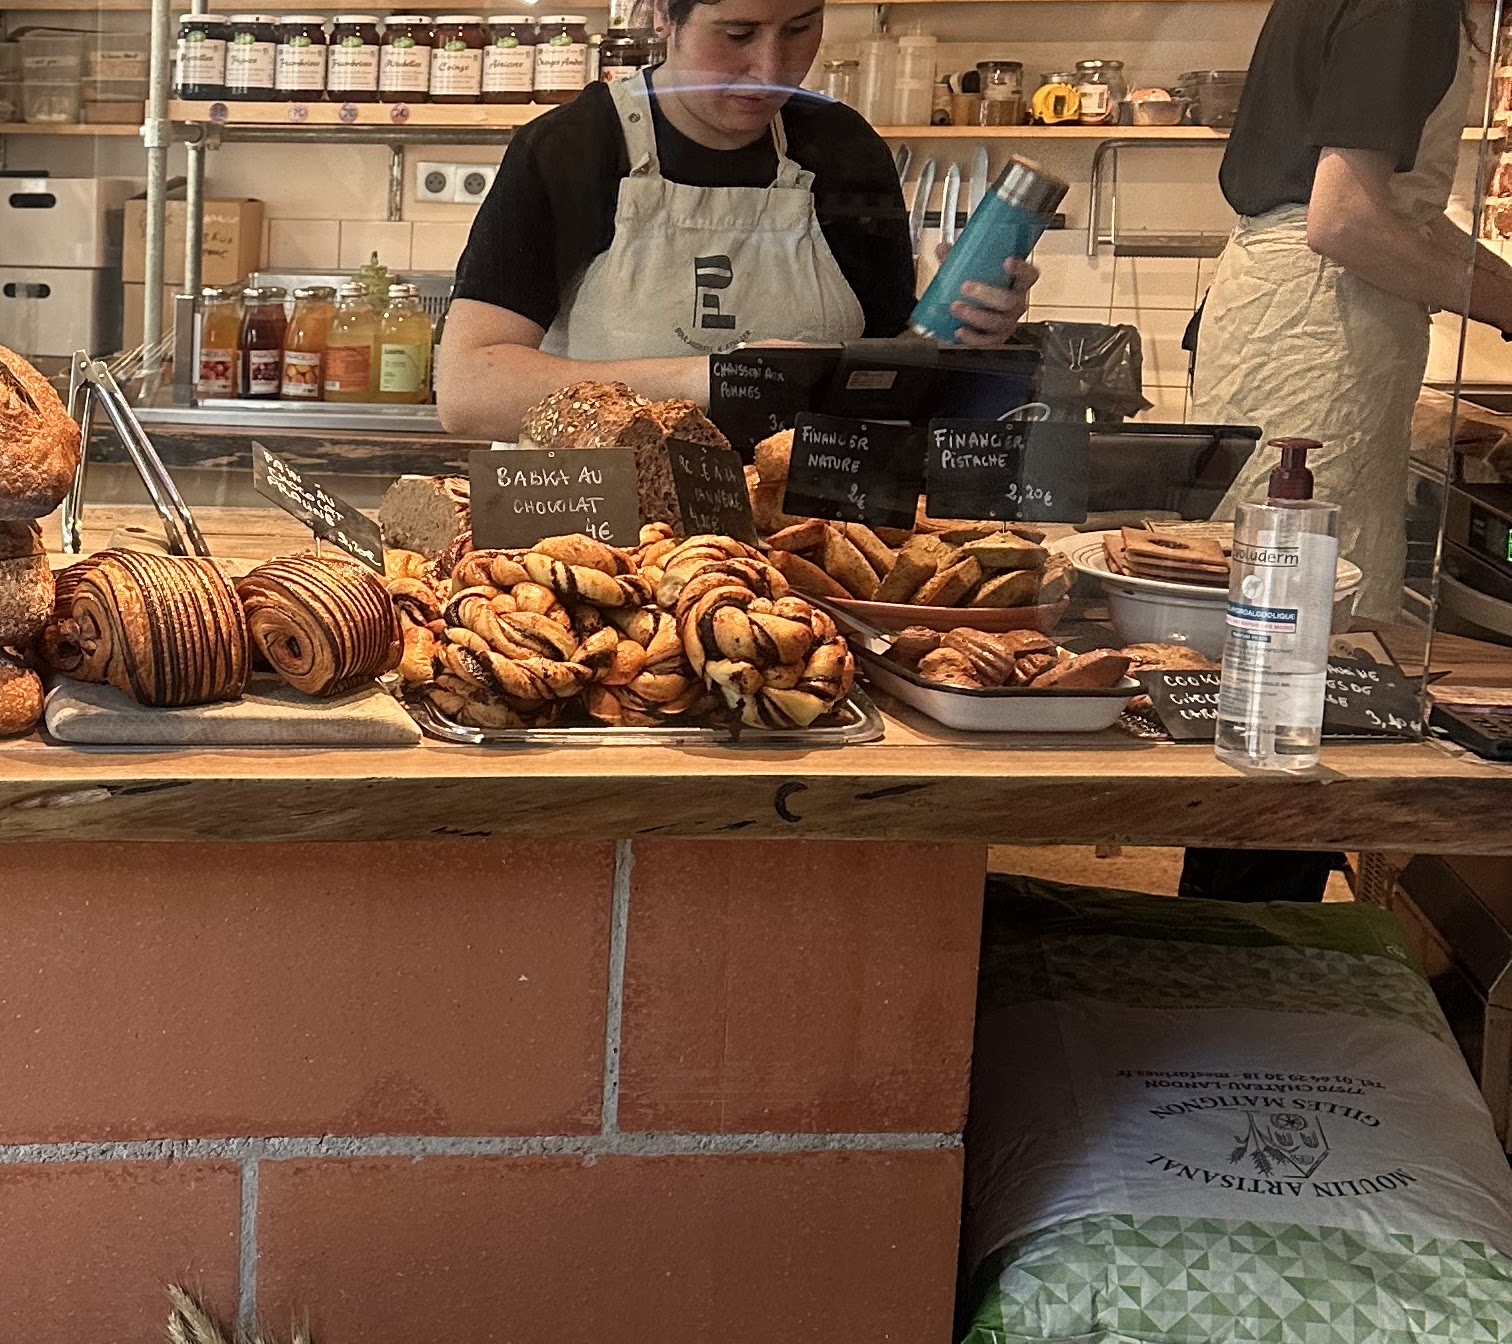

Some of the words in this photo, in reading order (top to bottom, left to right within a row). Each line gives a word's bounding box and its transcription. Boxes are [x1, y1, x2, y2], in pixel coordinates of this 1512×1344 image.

[578, 465, 603, 485] AU
[807, 454, 861, 473] NATURE
[512, 496, 605, 514] CHOCOLAT
[1148, 1094, 1286, 1120] MATIGNON
[1292, 1097, 1381, 1128] GILLES
[1145, 1152, 1302, 1197] ARTISANAL
[1315, 1167, 1418, 1198] MOULIN
